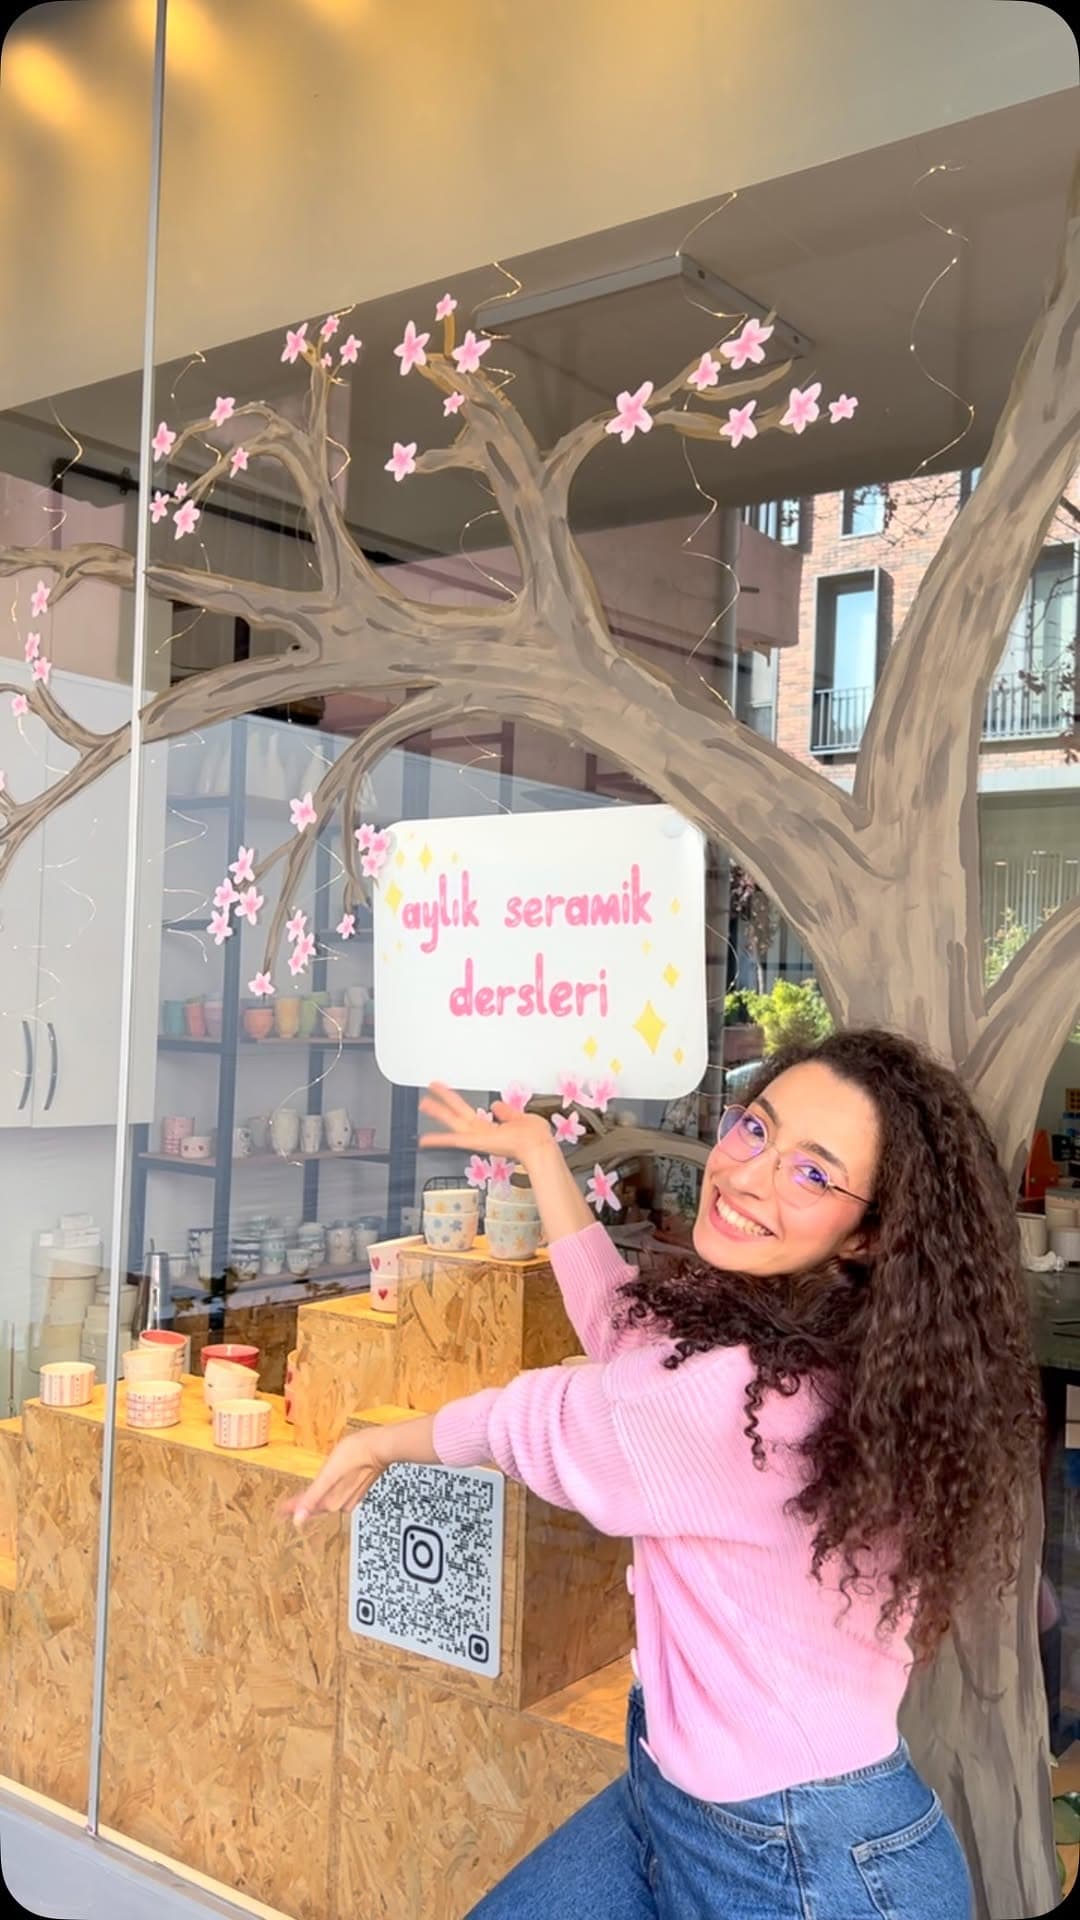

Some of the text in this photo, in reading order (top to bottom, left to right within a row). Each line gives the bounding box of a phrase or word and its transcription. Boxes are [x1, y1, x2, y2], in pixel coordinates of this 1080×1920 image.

[402, 864, 652, 953] aylık seramik
[449, 953, 608, 1017] dersleri
